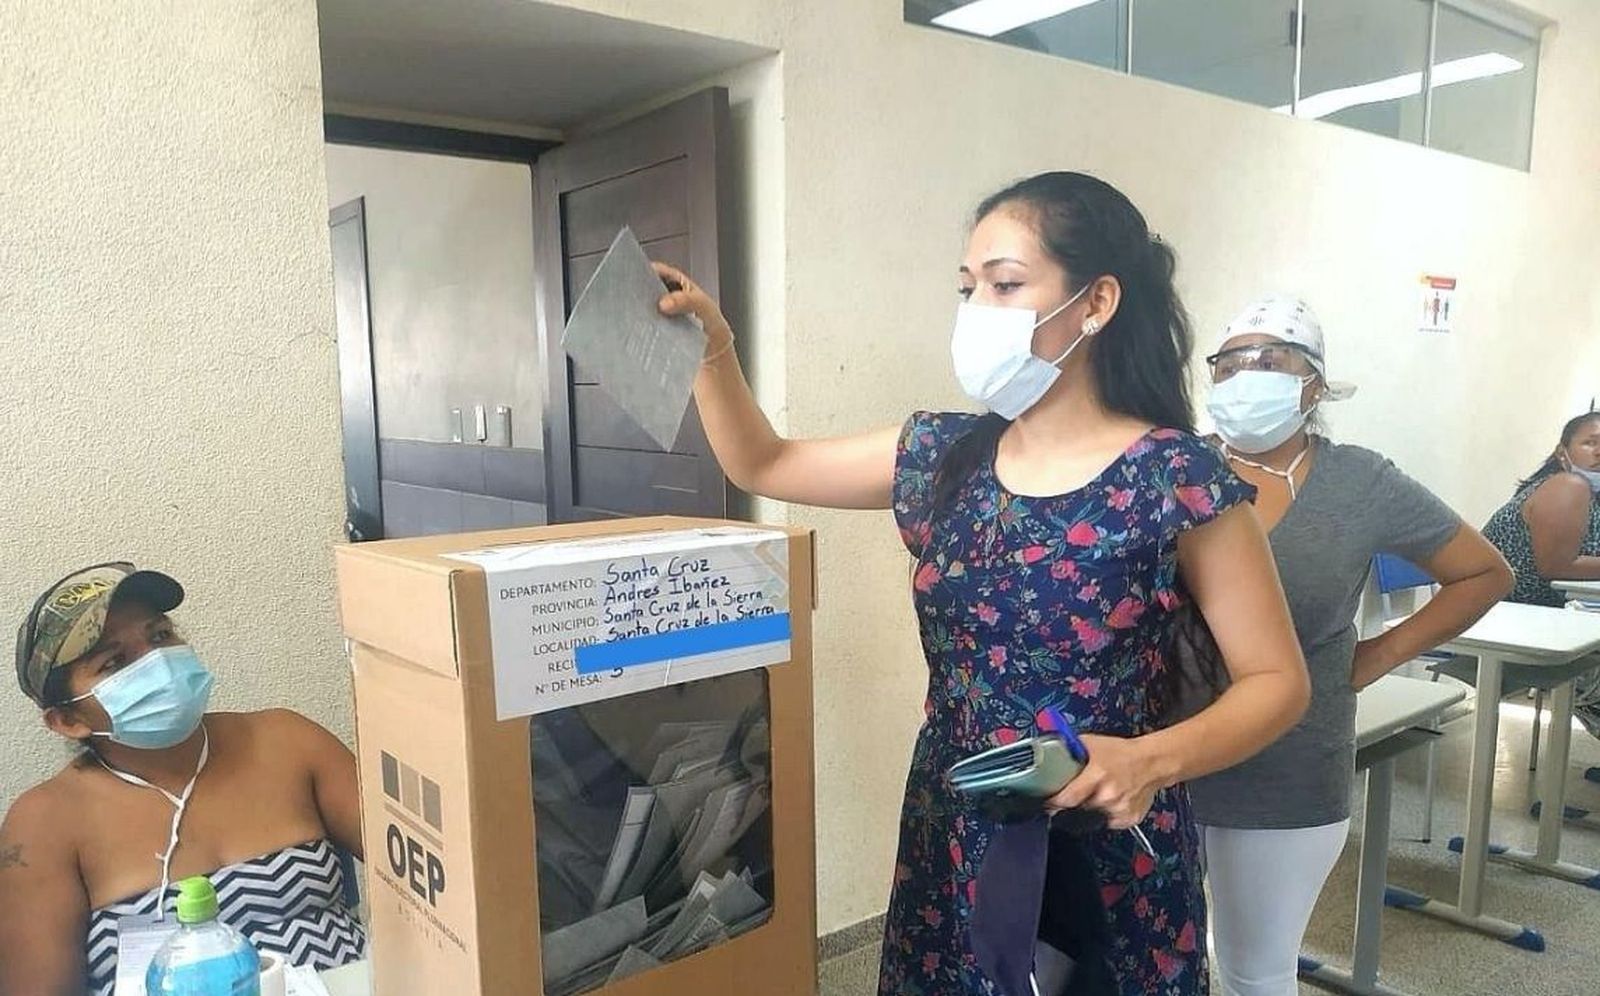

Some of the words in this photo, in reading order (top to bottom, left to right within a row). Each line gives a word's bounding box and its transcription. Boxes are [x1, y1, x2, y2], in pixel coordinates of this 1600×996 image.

[603, 558, 660, 585] Santa
[668, 556, 711, 577] Cruz
[500, 578, 597, 600] DEPARTAMENTO:
[604, 584, 660, 606] Andres
[668, 575, 731, 595] Ibañez
[532, 598, 598, 616] PROVINCIA:
[604, 602, 644, 624] Santa
[649, 600, 680, 617] Cruz
[686, 594, 700, 610] de
[707, 591, 718, 608] la
[723, 588, 763, 607] Sierra
[532, 616, 599, 636] MUNICIPIO:
[606, 619, 650, 643] Santa
[656, 618, 690, 634] Cruz
[695, 611, 709, 627] de
[716, 609, 729, 624] la
[736, 605, 775, 621] Sierra
[548, 659, 575, 673] RECI
[552, 680, 568, 692] DE
[387, 823, 446, 908] OEP
